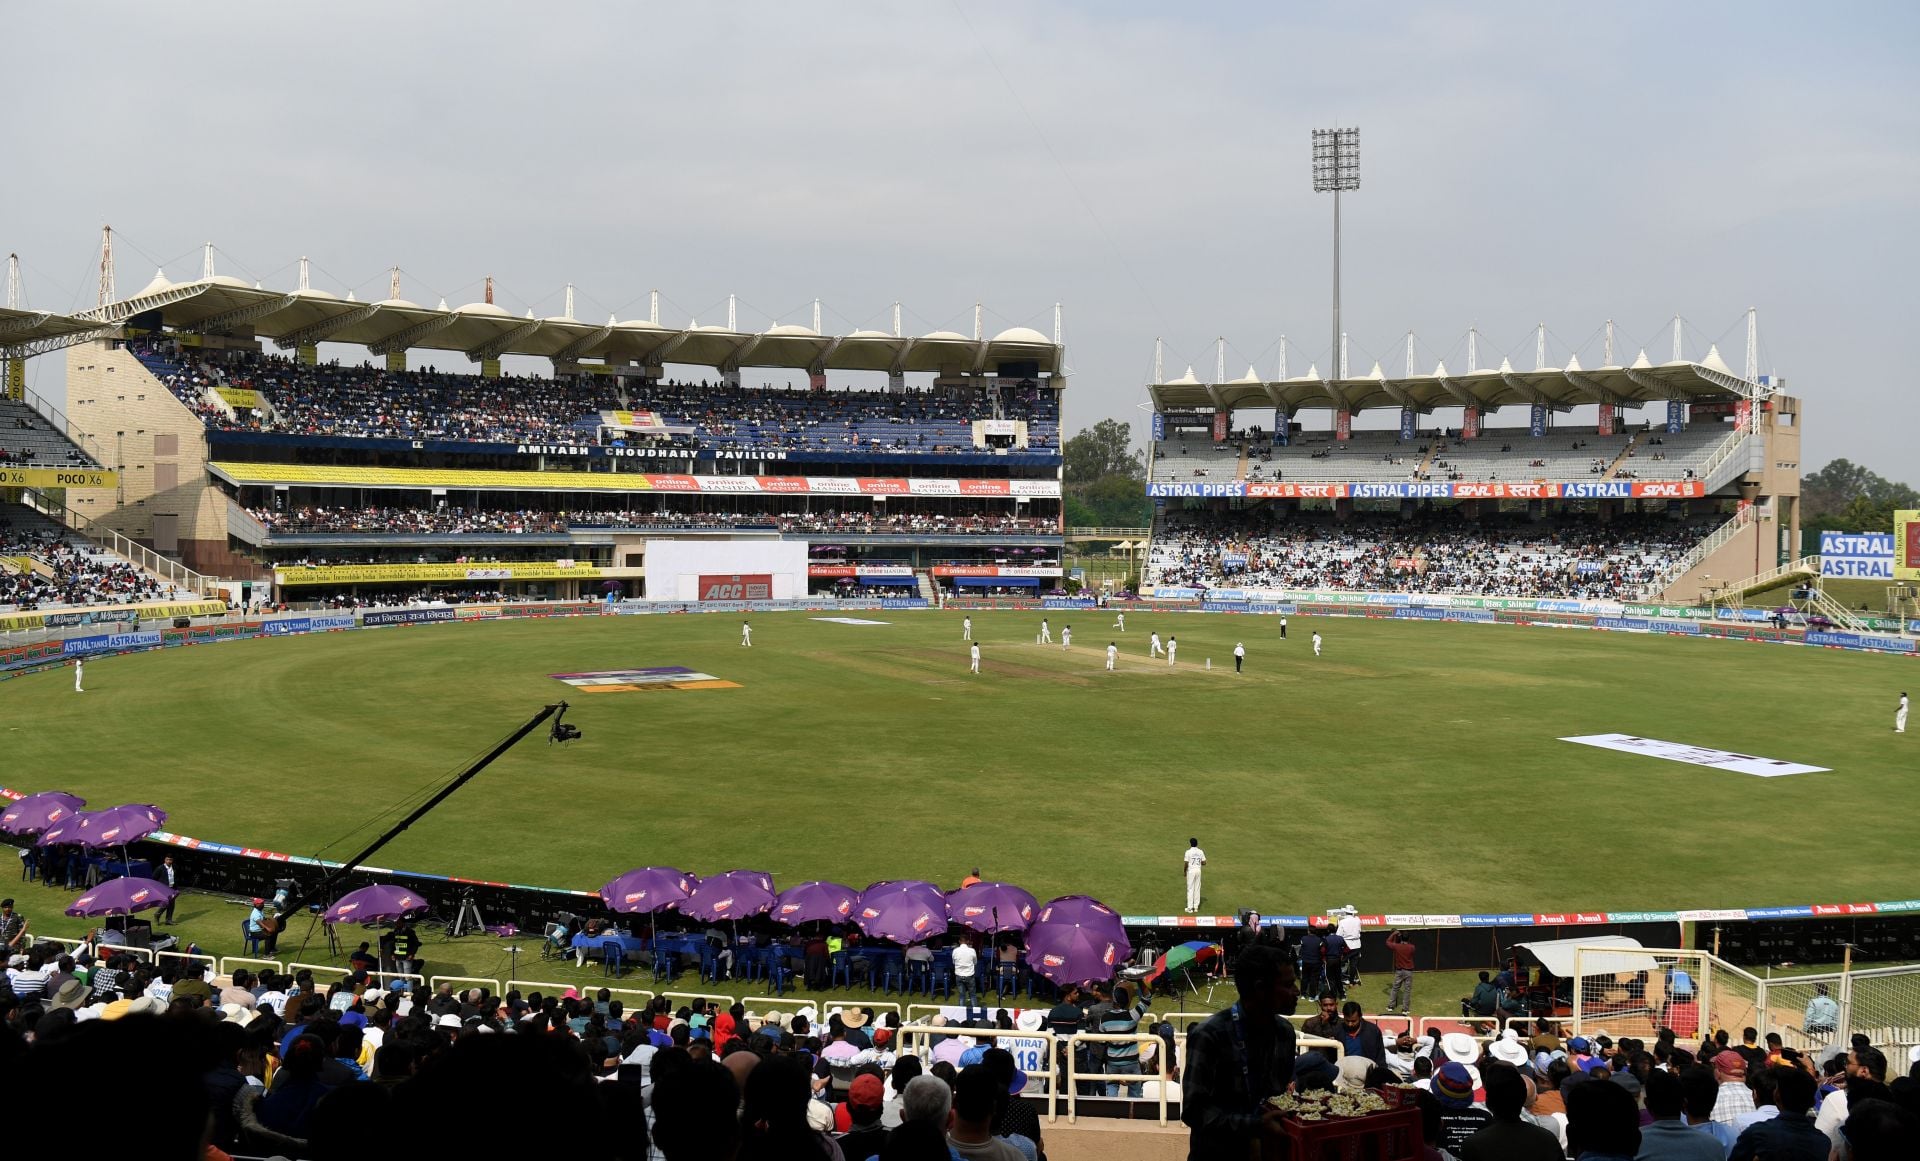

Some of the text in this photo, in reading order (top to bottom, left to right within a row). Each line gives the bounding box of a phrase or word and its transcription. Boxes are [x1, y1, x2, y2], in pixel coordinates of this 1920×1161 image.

[517, 445, 787, 459] AMITABH CHOUDHARY PAVILION
[11, 472, 24, 482] X6
[57, 474, 102, 485] POCO X6
[1150, 484, 1241, 496] ASTRAL PIPES
[1353, 485, 1448, 497] ASTRAL PIPES
[1564, 485, 1628, 496] ASTRAL
[1822, 537, 1894, 554] ASTRAL
[1822, 560, 1893, 577] ASTRAL
[704, 585, 743, 599] ACC
[882, 599, 909, 607] ASTRAL
[1203, 602, 1230, 610] ASTRAL
[1450, 598, 1477, 606] Shikhar
[1507, 600, 1535, 608] Shikhar
[1536, 601, 1559, 611] Lubi
[1396, 608, 1425, 616] ASTRAL
[1446, 610, 1474, 618] ASTRAL
[1625, 606, 1655, 616] Shikhar
[1685, 608, 1712, 617] Shikha
[312, 618, 337, 628] ASTRAL
[1597, 619, 1627, 627] ASTRAL
[1650, 622, 1680, 630] ASTRAL
[109, 634, 140, 648] ASTRAL
[140, 634, 160, 643] TANKS
[1807, 634, 1859, 645] ASTRAL TANKS
[1861, 638, 1914, 650] ASTRAL TANKS
[64, 640, 91, 653] ASTRAL
[91, 640, 107, 648] TANKS
[1817, 905, 1840, 913] Amul
[1849, 904, 1872, 912] Amul
[1360, 917, 1380, 925] mul
[1540, 914, 1565, 923] Amul
[1577, 913, 1602, 922] Amul
[1615, 913, 1642, 921] Simpolo
[1014, 1038, 1043, 1048] VIRAT
[1017, 1050, 1037, 1072] 18
